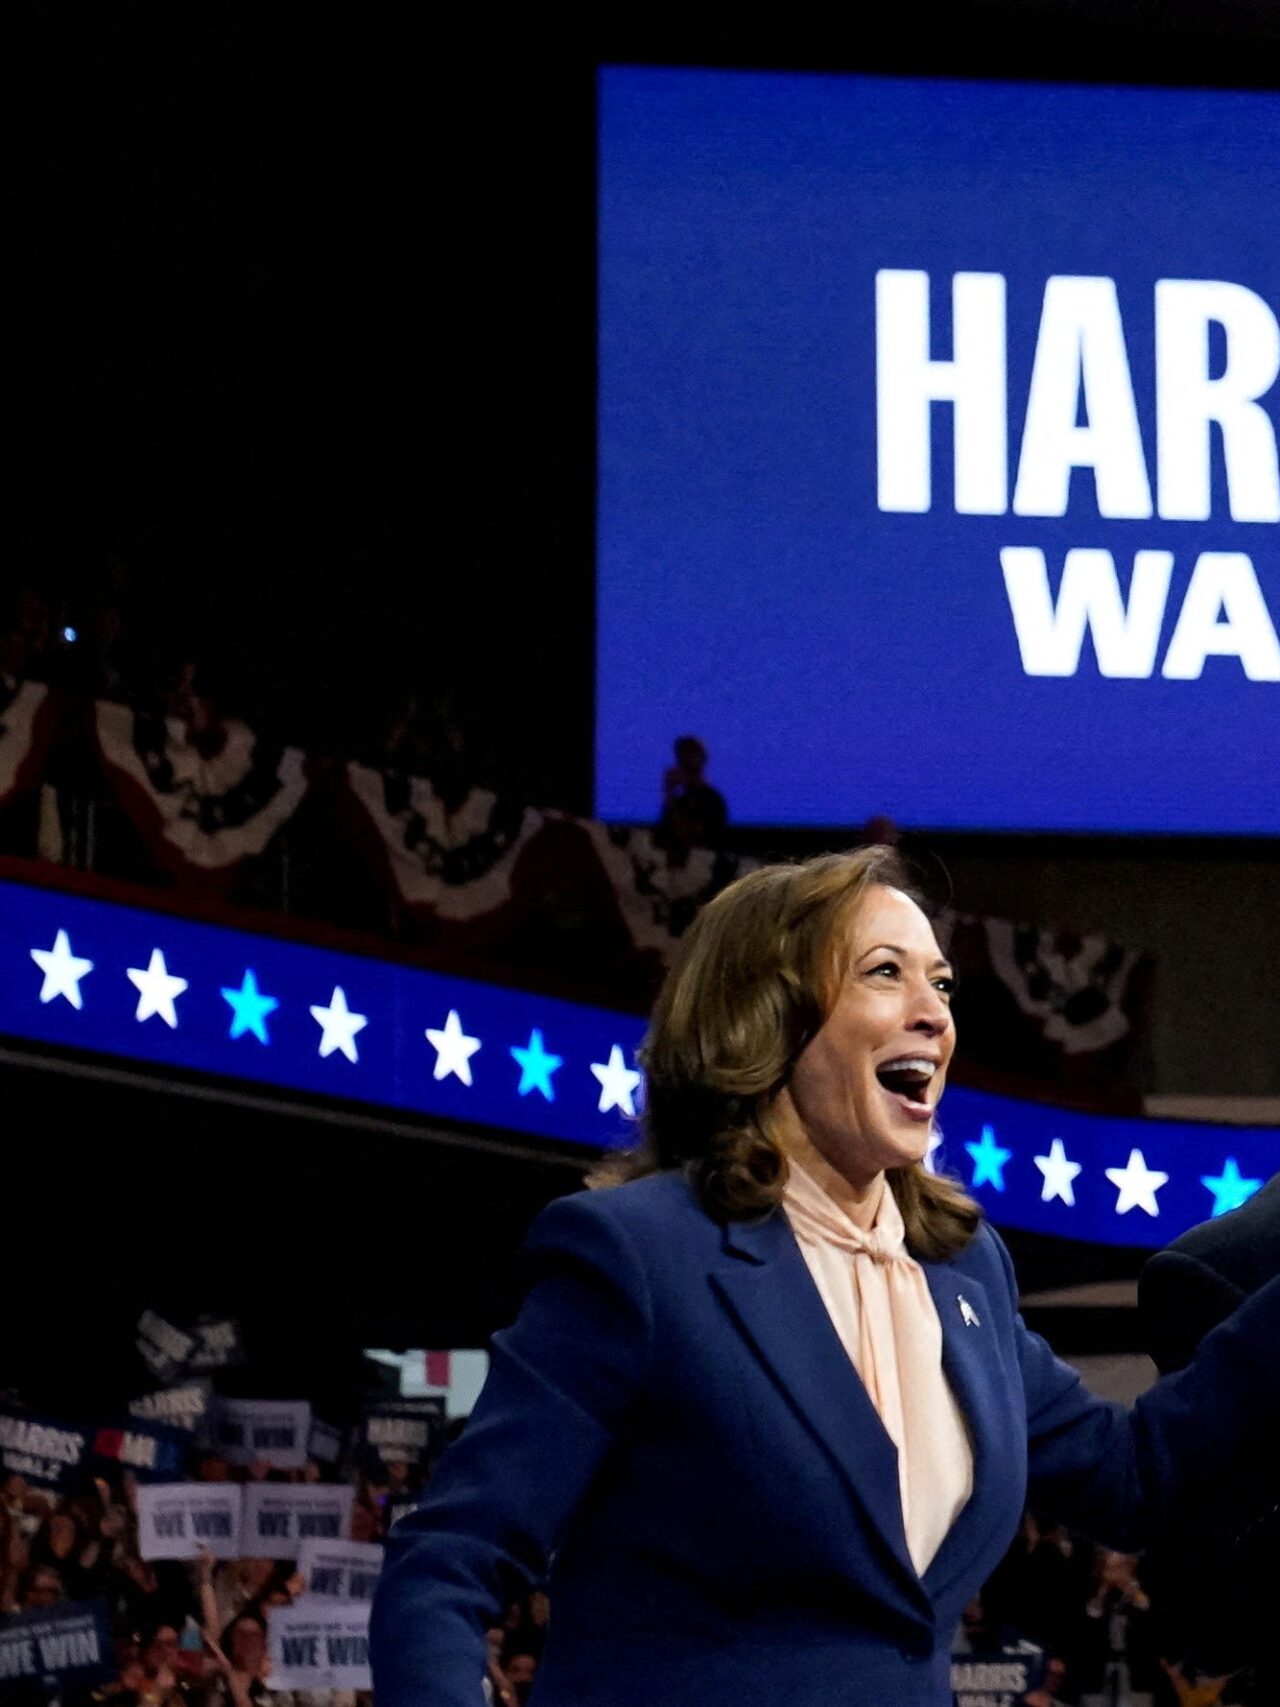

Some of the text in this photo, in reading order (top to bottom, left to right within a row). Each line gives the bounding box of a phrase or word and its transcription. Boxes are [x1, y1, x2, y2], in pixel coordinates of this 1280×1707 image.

[153, 1512, 185, 1538] WE
[39, 1629, 100, 1671] WIN
[280, 1636, 317, 1667] WE
